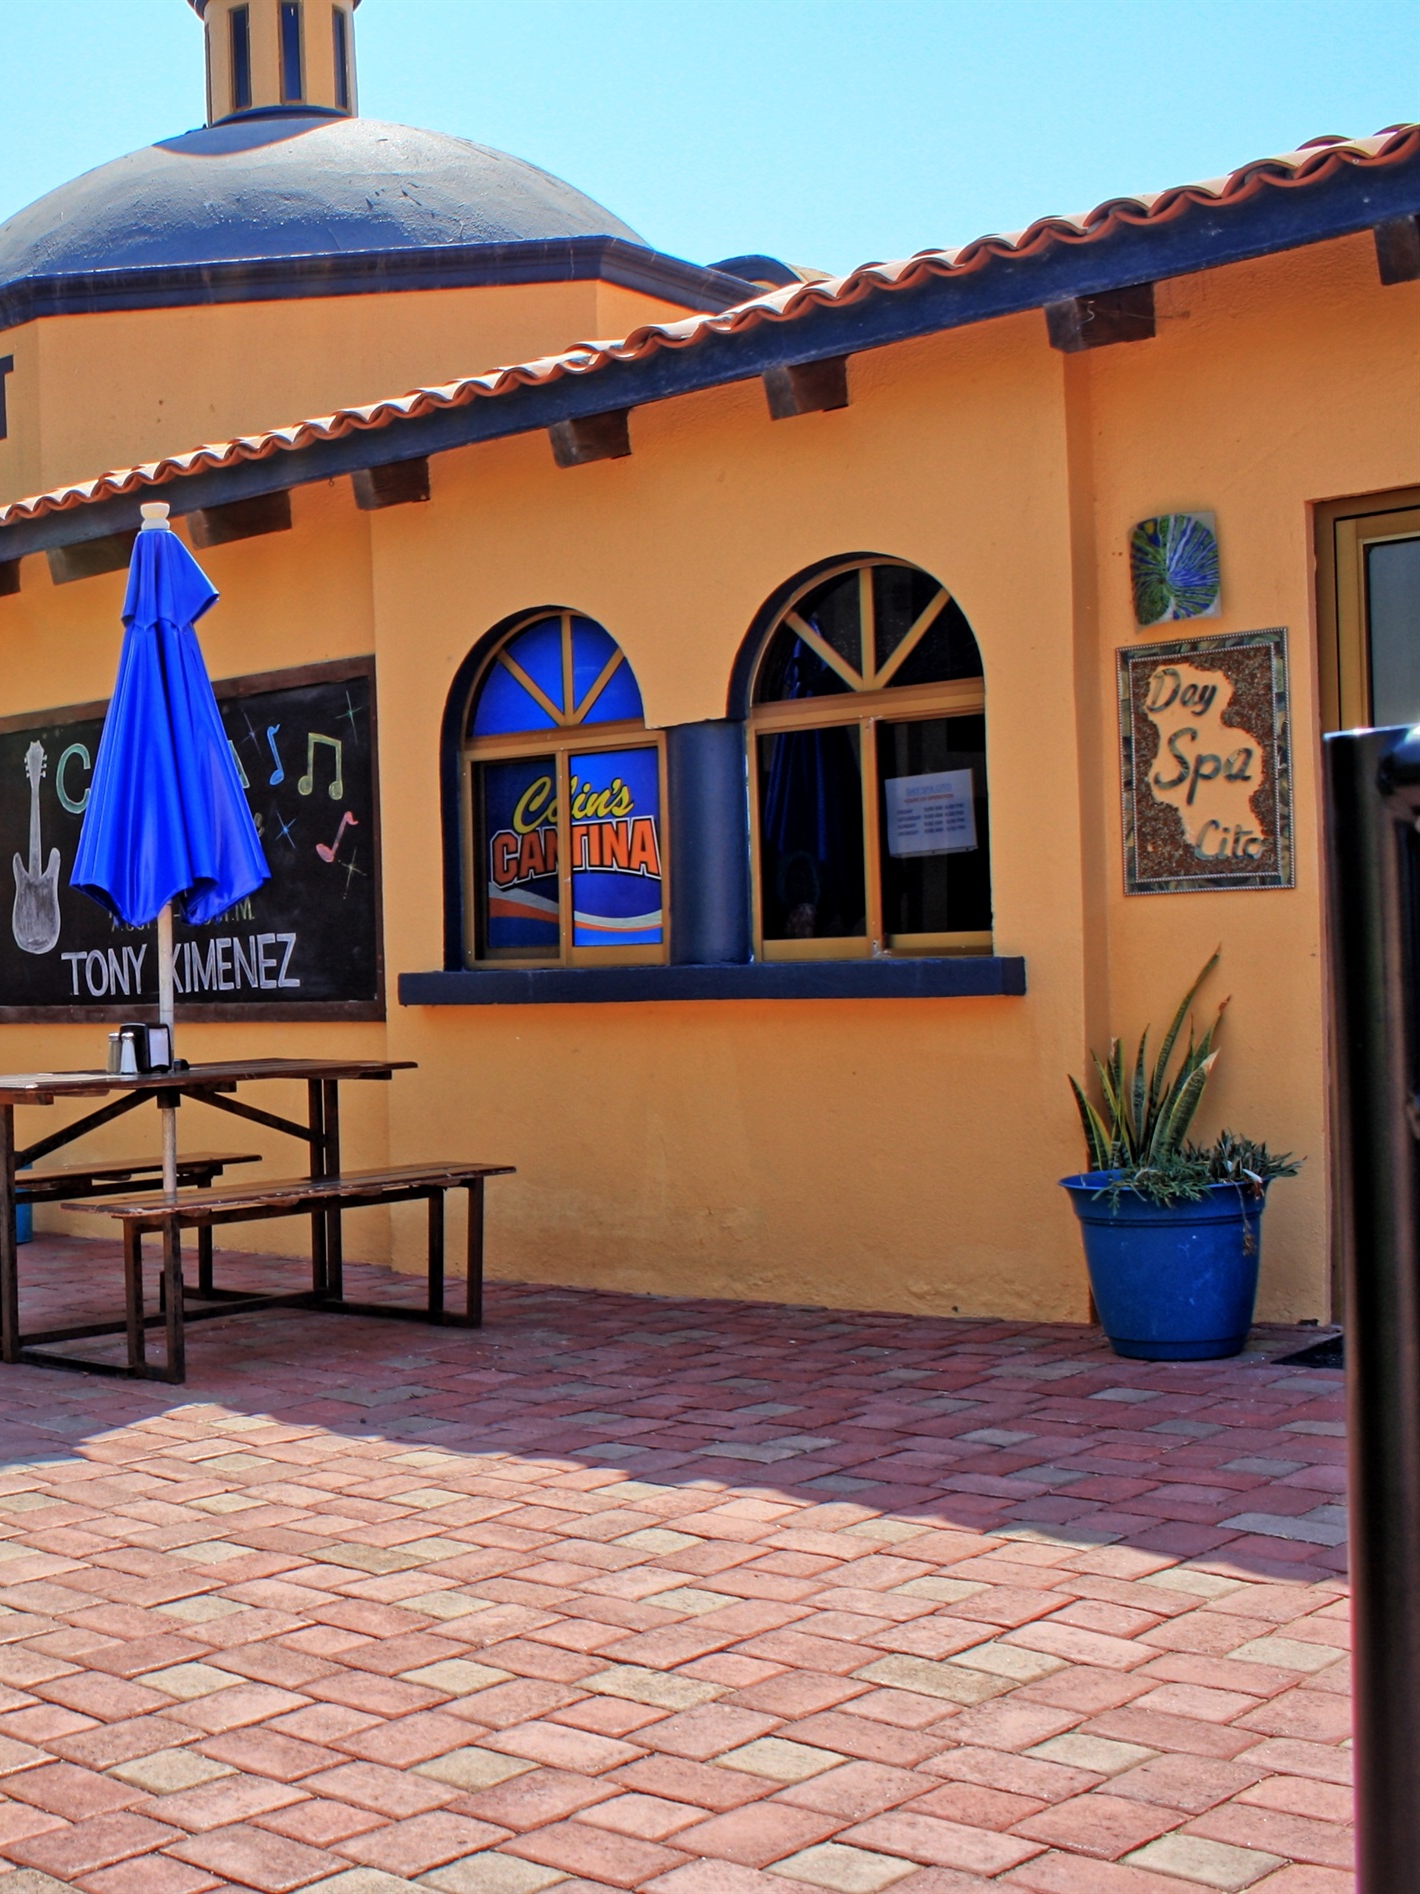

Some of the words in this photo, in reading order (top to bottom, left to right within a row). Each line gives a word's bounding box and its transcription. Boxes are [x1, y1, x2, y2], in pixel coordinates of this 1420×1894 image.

[1145, 668, 1217, 717] Day
[1154, 727, 1253, 805] Spa
[61, 943, 147, 997] TONY
